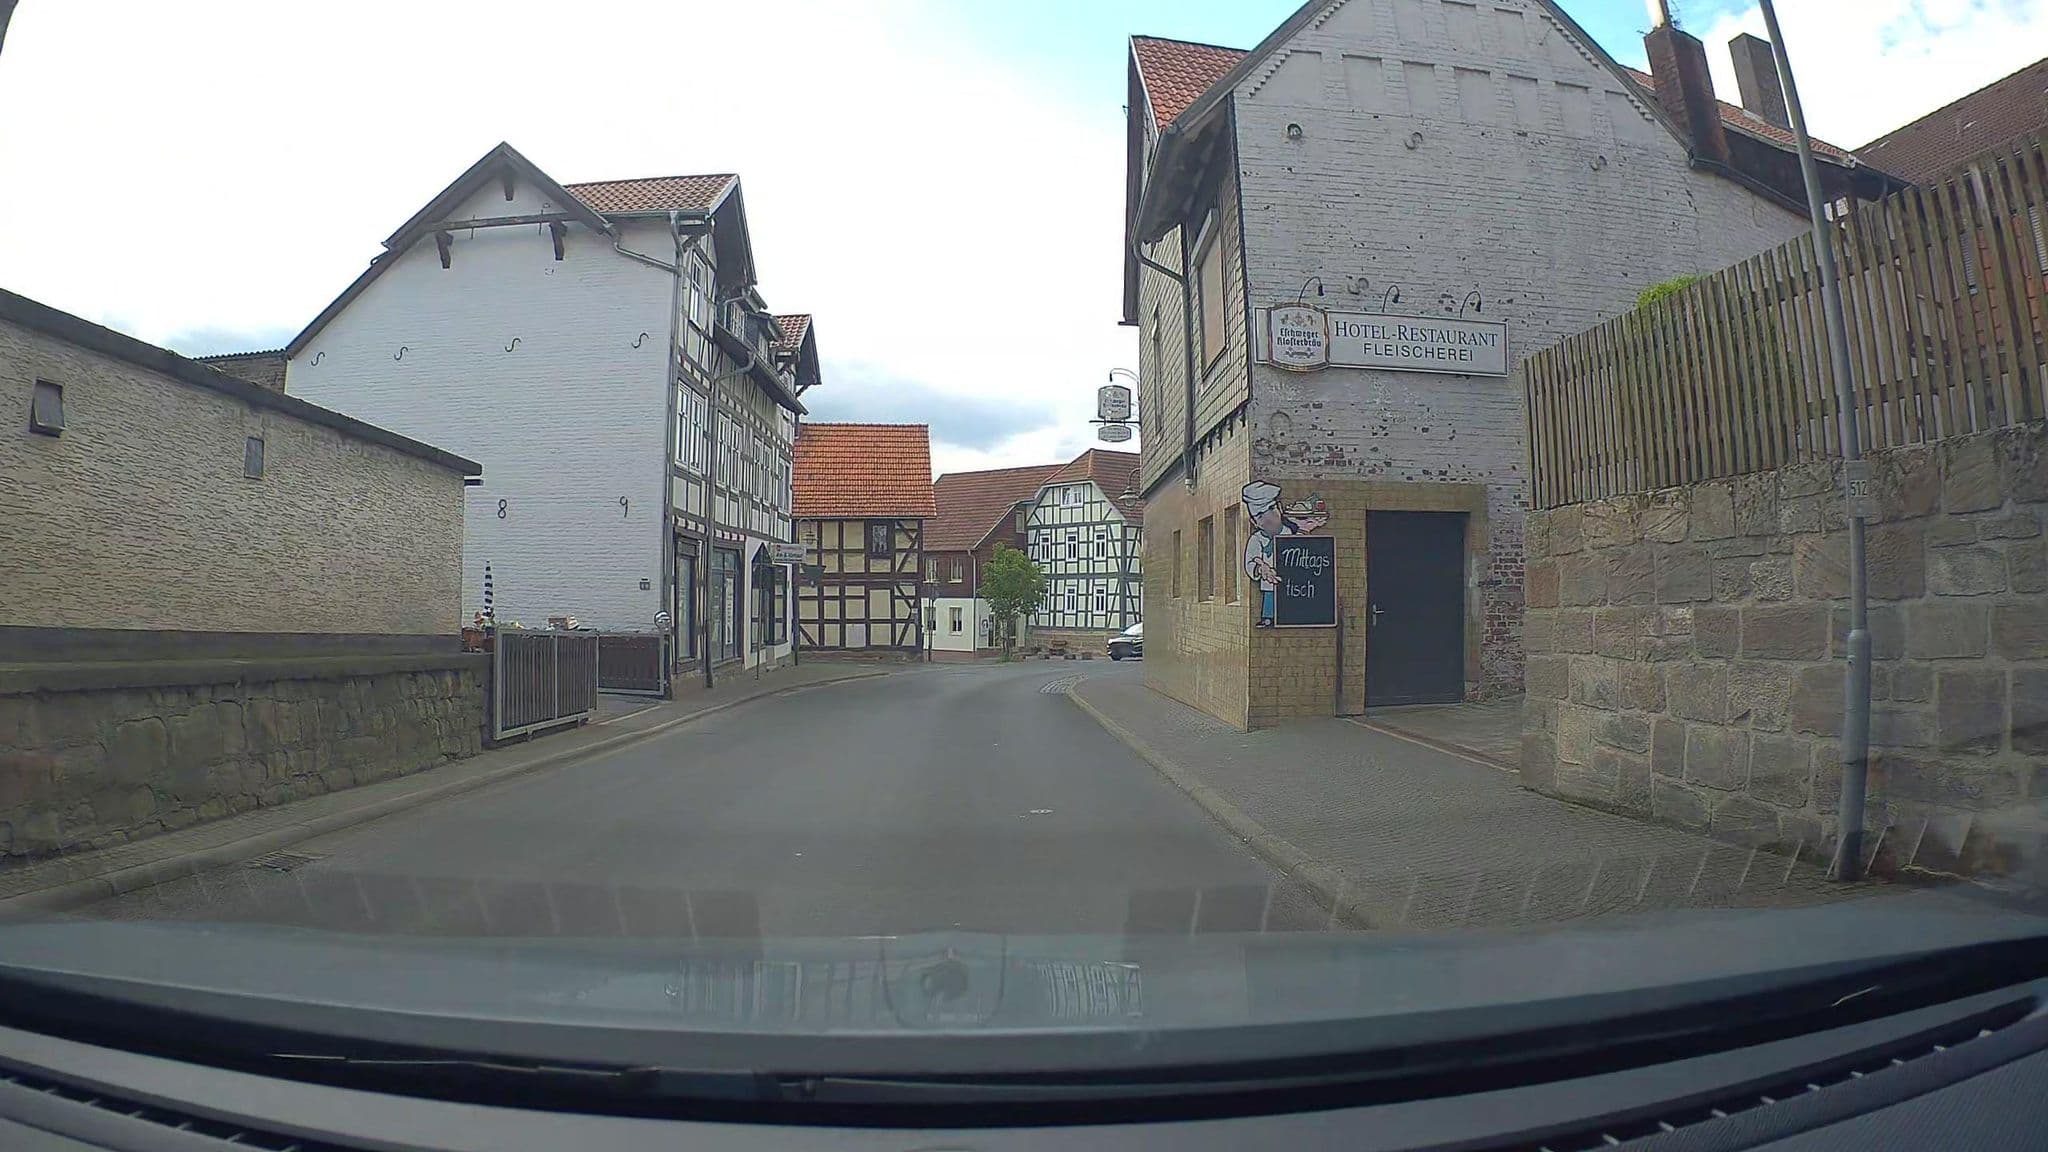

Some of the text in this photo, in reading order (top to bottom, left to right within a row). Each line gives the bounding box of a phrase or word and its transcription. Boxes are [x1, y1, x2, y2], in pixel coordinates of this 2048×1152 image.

[1363, 342, 1473, 361] FLEISCHEREI
[1850, 481, 1867, 496] 512
[1282, 548, 1330, 576] Mittags
[1286, 580, 1314, 598] tisch
